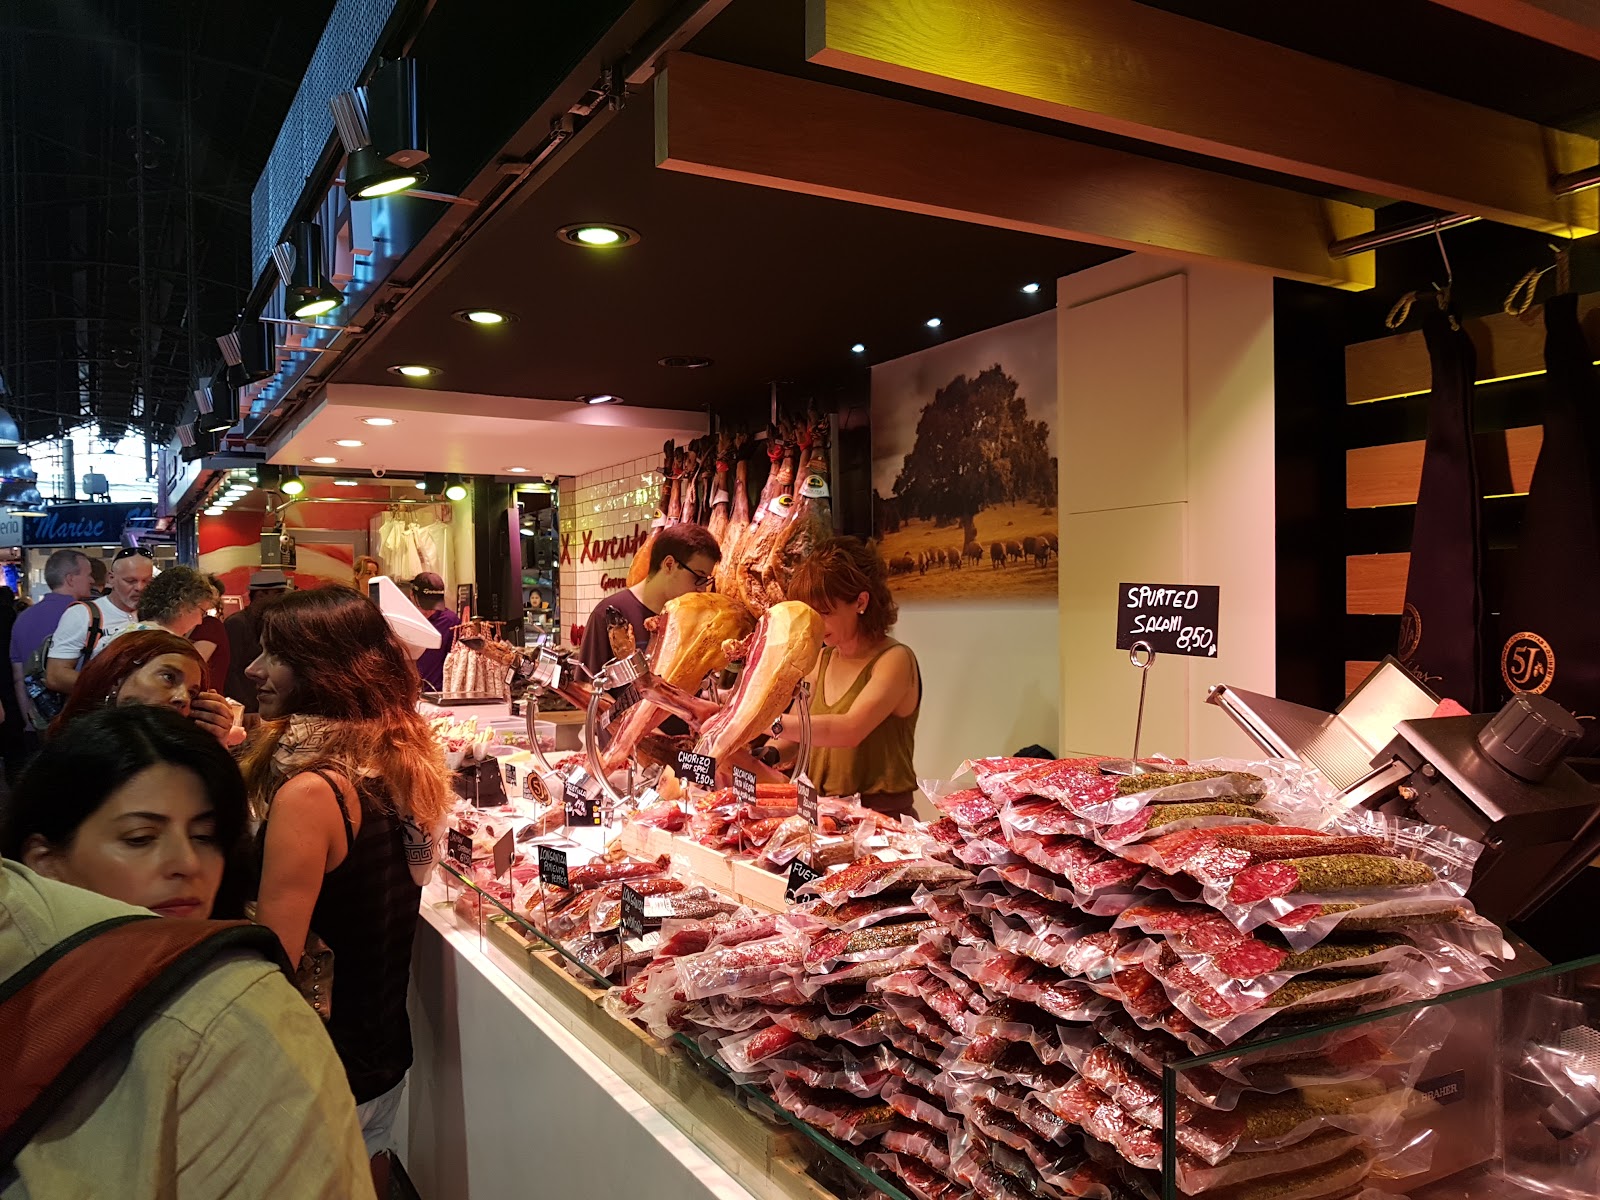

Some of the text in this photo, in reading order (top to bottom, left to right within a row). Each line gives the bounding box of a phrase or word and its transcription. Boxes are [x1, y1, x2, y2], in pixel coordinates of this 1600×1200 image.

[1127, 585, 1199, 610] SPURTED
[1510, 645, 1541, 684] 5J
[677, 751, 711, 767] CHORIZO
[1421, 1083, 1458, 1102] BRAHER
